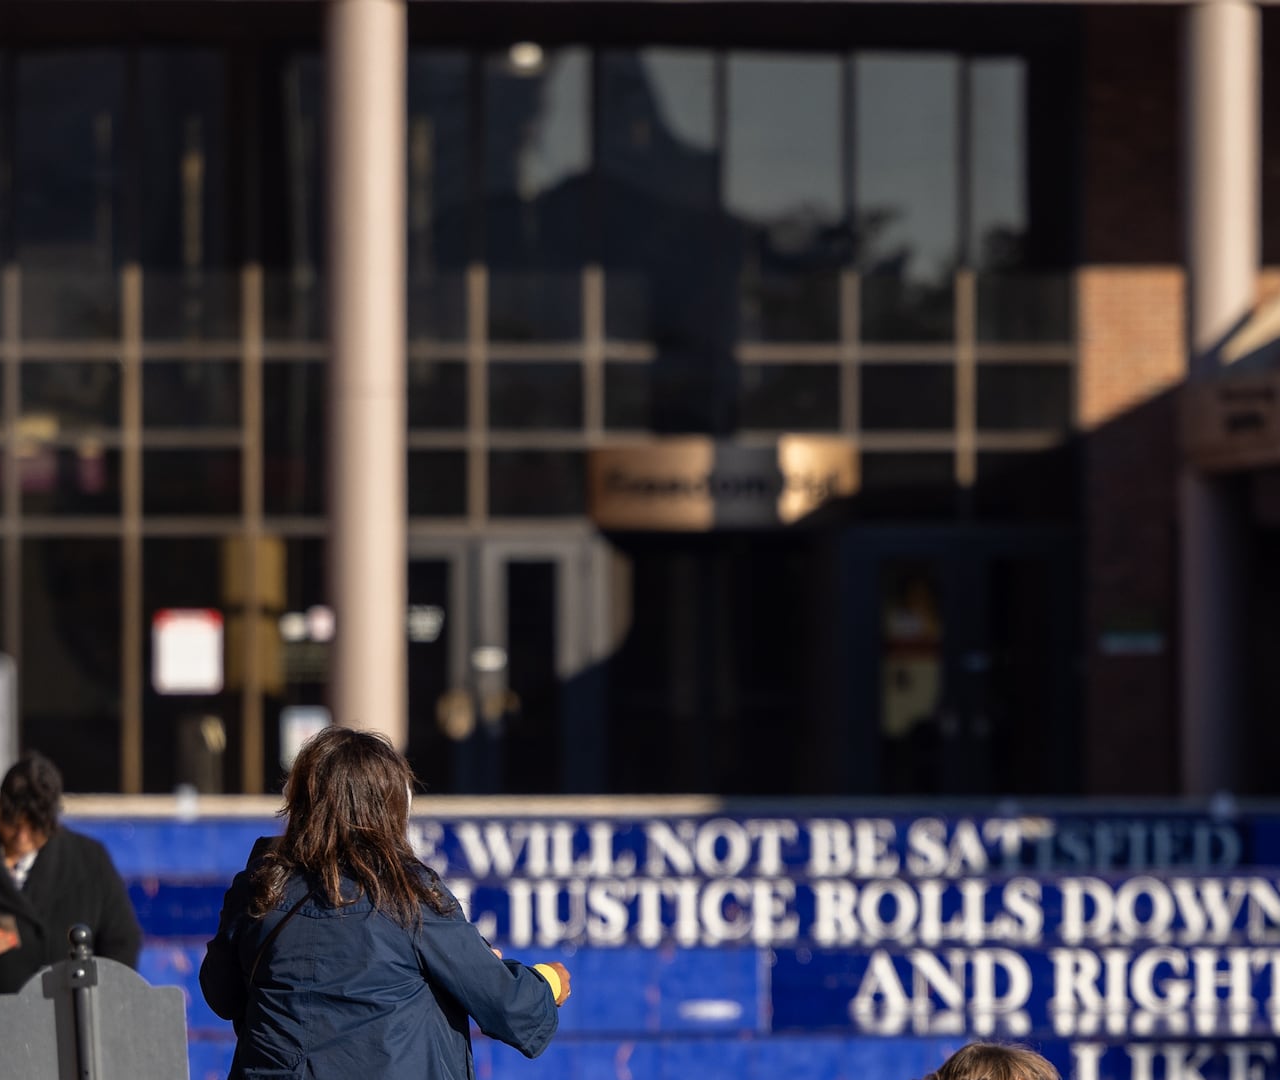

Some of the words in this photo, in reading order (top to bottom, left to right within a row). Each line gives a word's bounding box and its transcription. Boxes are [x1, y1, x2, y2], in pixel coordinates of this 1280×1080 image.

[407, 820, 448, 878] E
[454, 820, 638, 878] WILL
[644, 818, 798, 878] NOT
[809, 818, 901, 878] BE
[907, 818, 1243, 878] SATISFIED
[507, 878, 801, 948] JUSTICE
[813, 878, 1045, 946] ROLLS
[850, 946, 1033, 1020] AND
